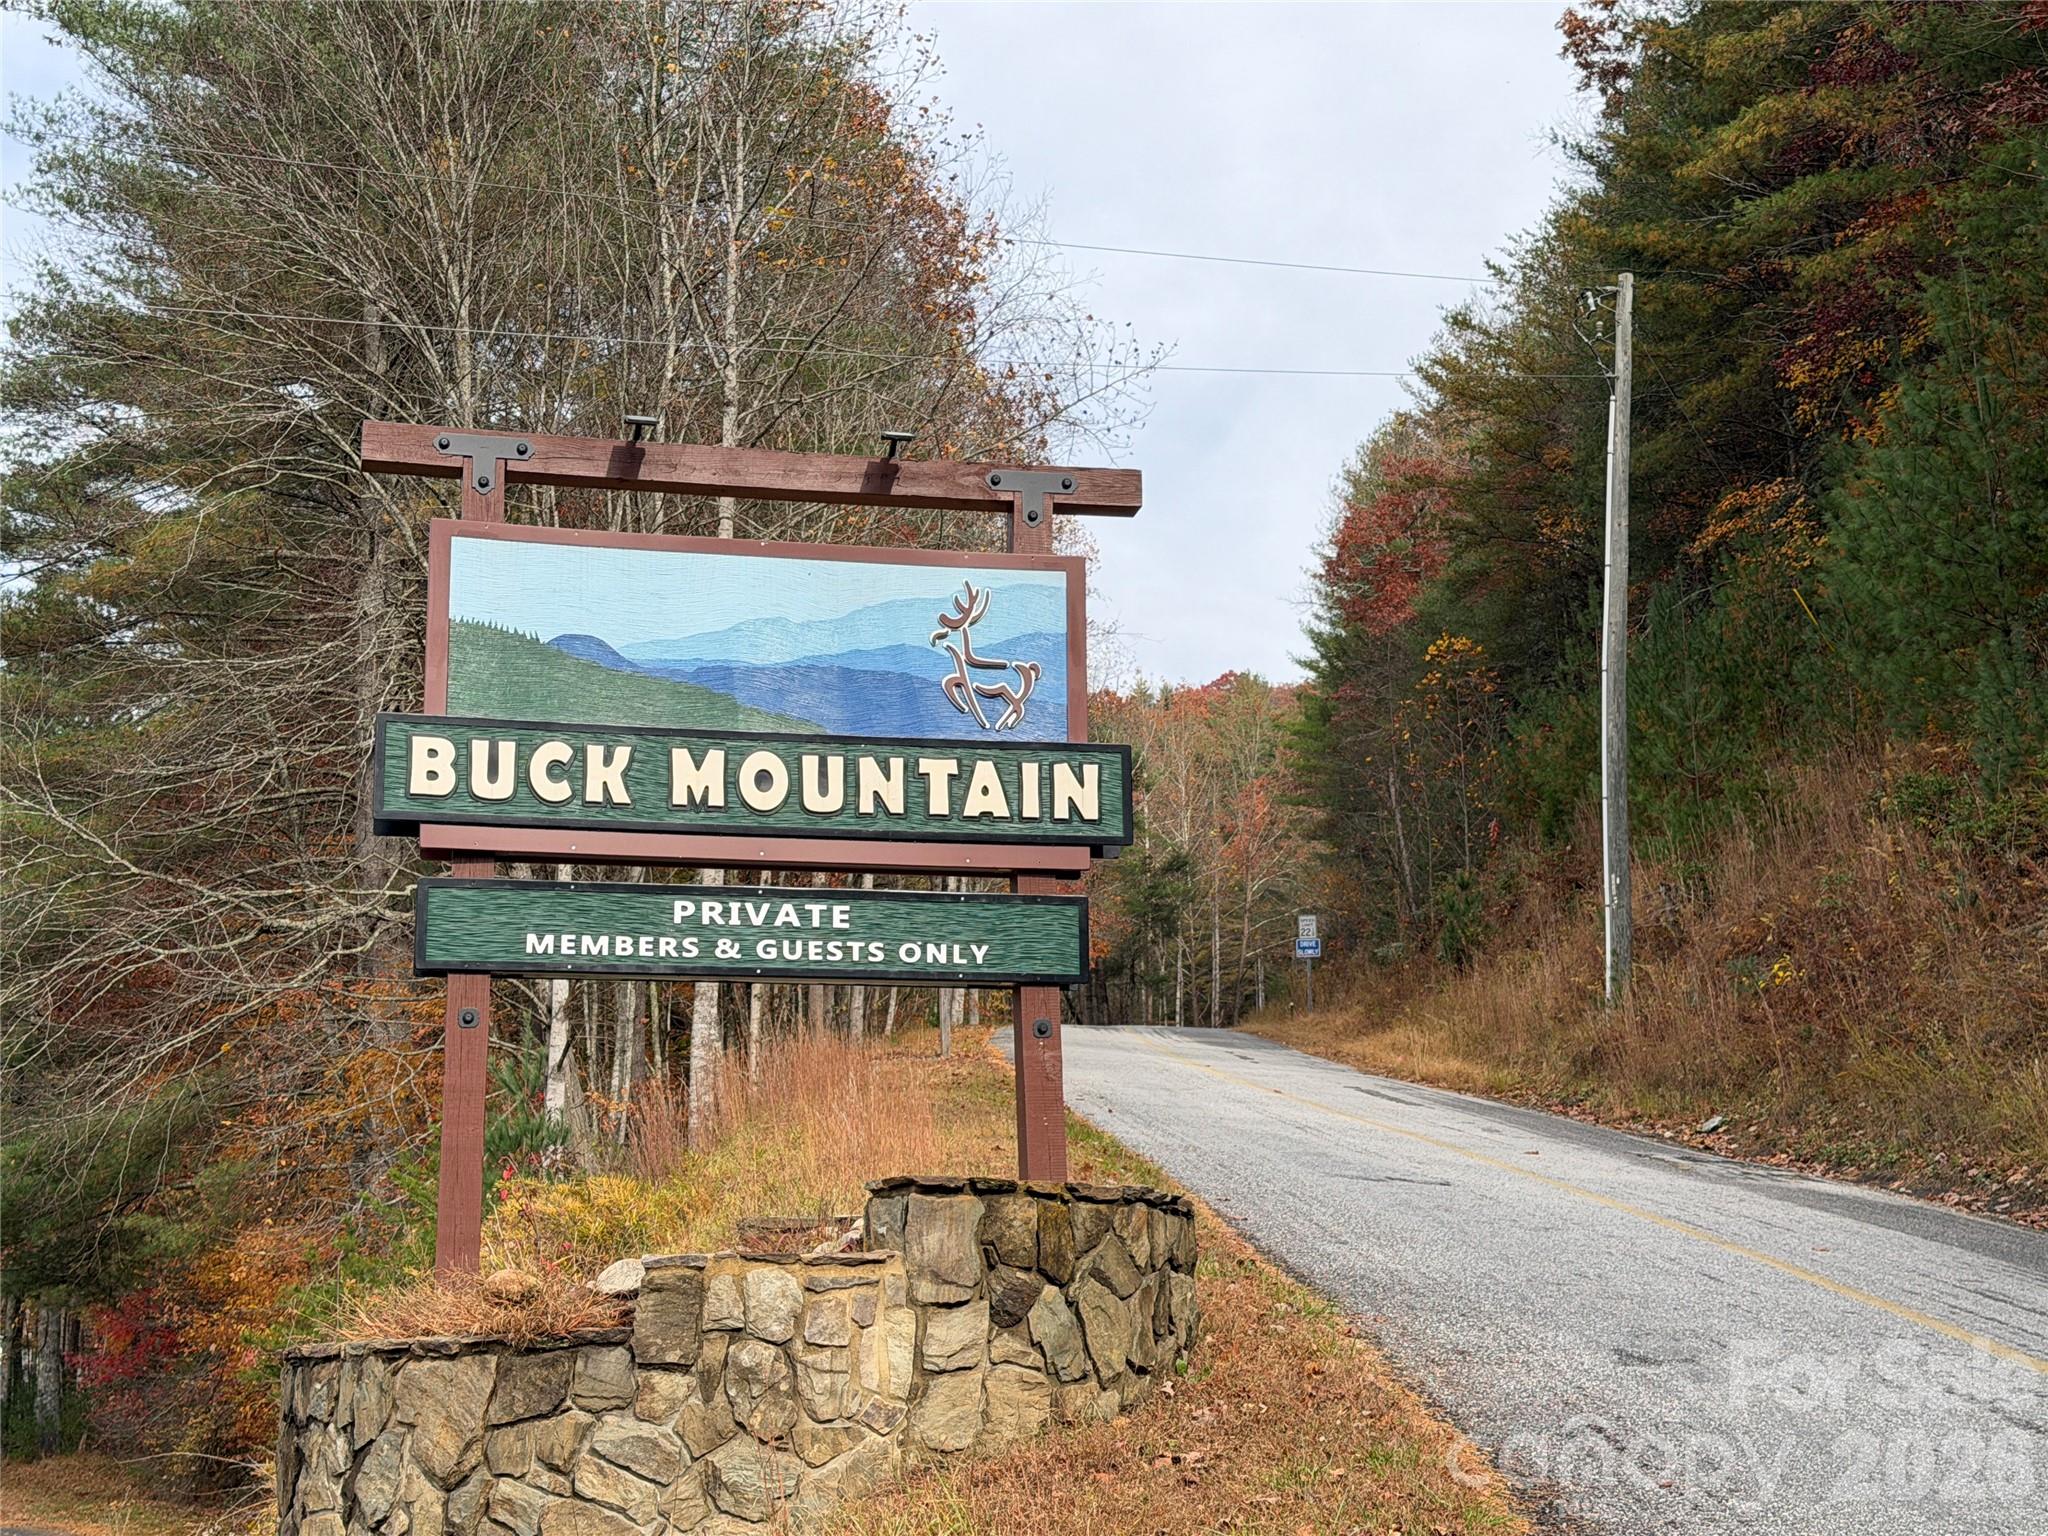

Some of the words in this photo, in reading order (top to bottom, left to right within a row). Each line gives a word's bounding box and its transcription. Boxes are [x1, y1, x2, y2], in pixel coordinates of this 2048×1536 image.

[409, 735, 632, 805] BUCK
[670, 747, 1099, 820] MOUNTAIN
[673, 900, 850, 929] PRIVATE
[525, 933, 699, 958] MEMBERS
[714, 937, 742, 960] &
[756, 939, 885, 962] GUESTS
[899, 942, 989, 965] ONLY
